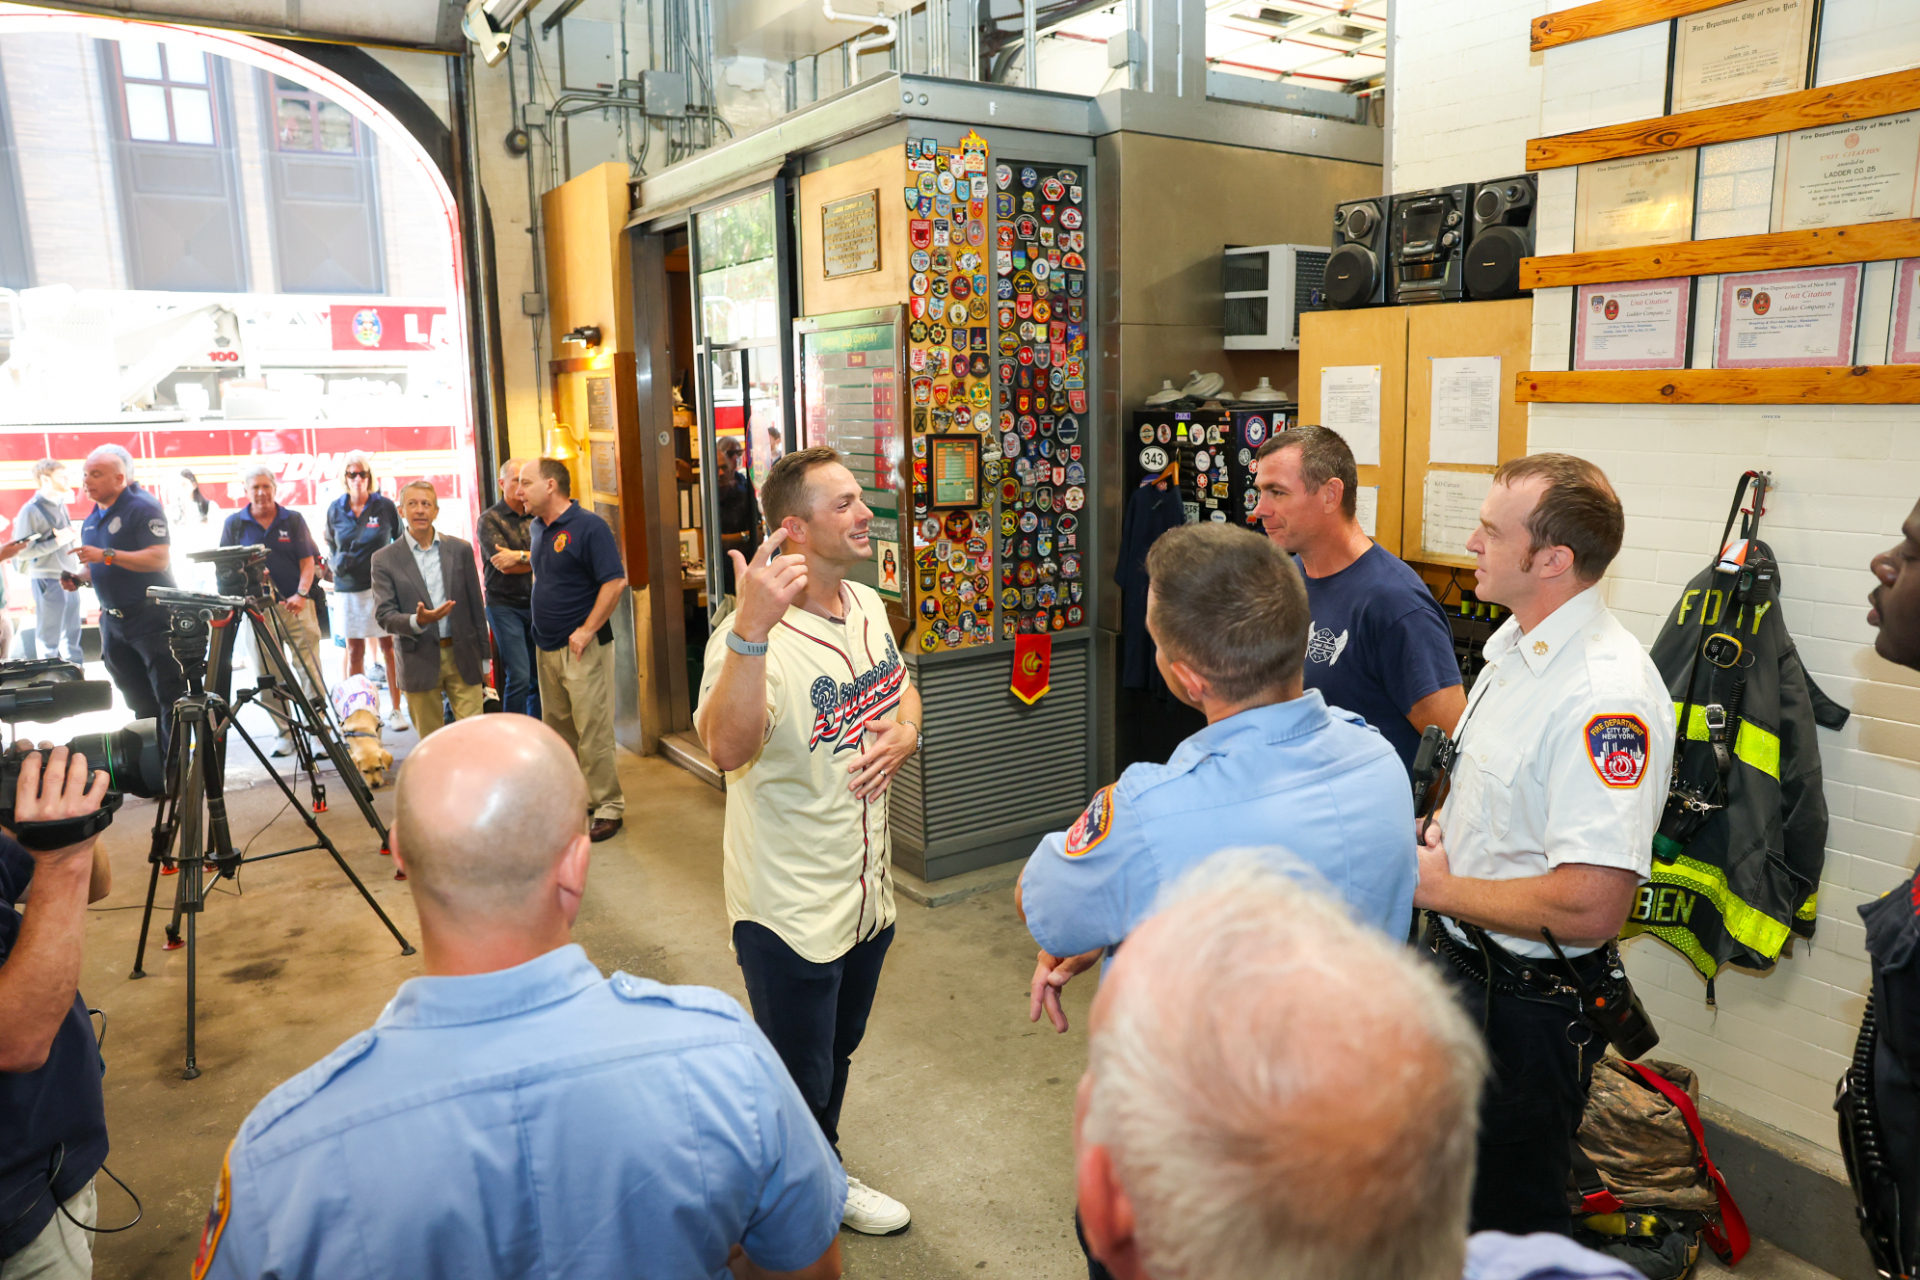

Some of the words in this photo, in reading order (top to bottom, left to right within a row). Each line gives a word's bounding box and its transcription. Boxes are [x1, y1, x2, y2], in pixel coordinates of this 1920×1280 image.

[1895, 117, 1911, 125] York
[1824, 169, 1852, 179] LADDER
[1866, 165, 1877, 173] 25
[1784, 291, 1800, 299] Unit
[1801, 290, 1832, 299] Citation
[1644, 298, 1669, 306] Citation
[1800, 303, 1826, 311] Company
[207, 351, 239, 362] 100
[1144, 452, 1164, 466] 343
[1677, 588, 1772, 635] FDY
[1590, 722, 1606, 737] FIRE
[1604, 718, 1645, 736] DEPARTMENT
